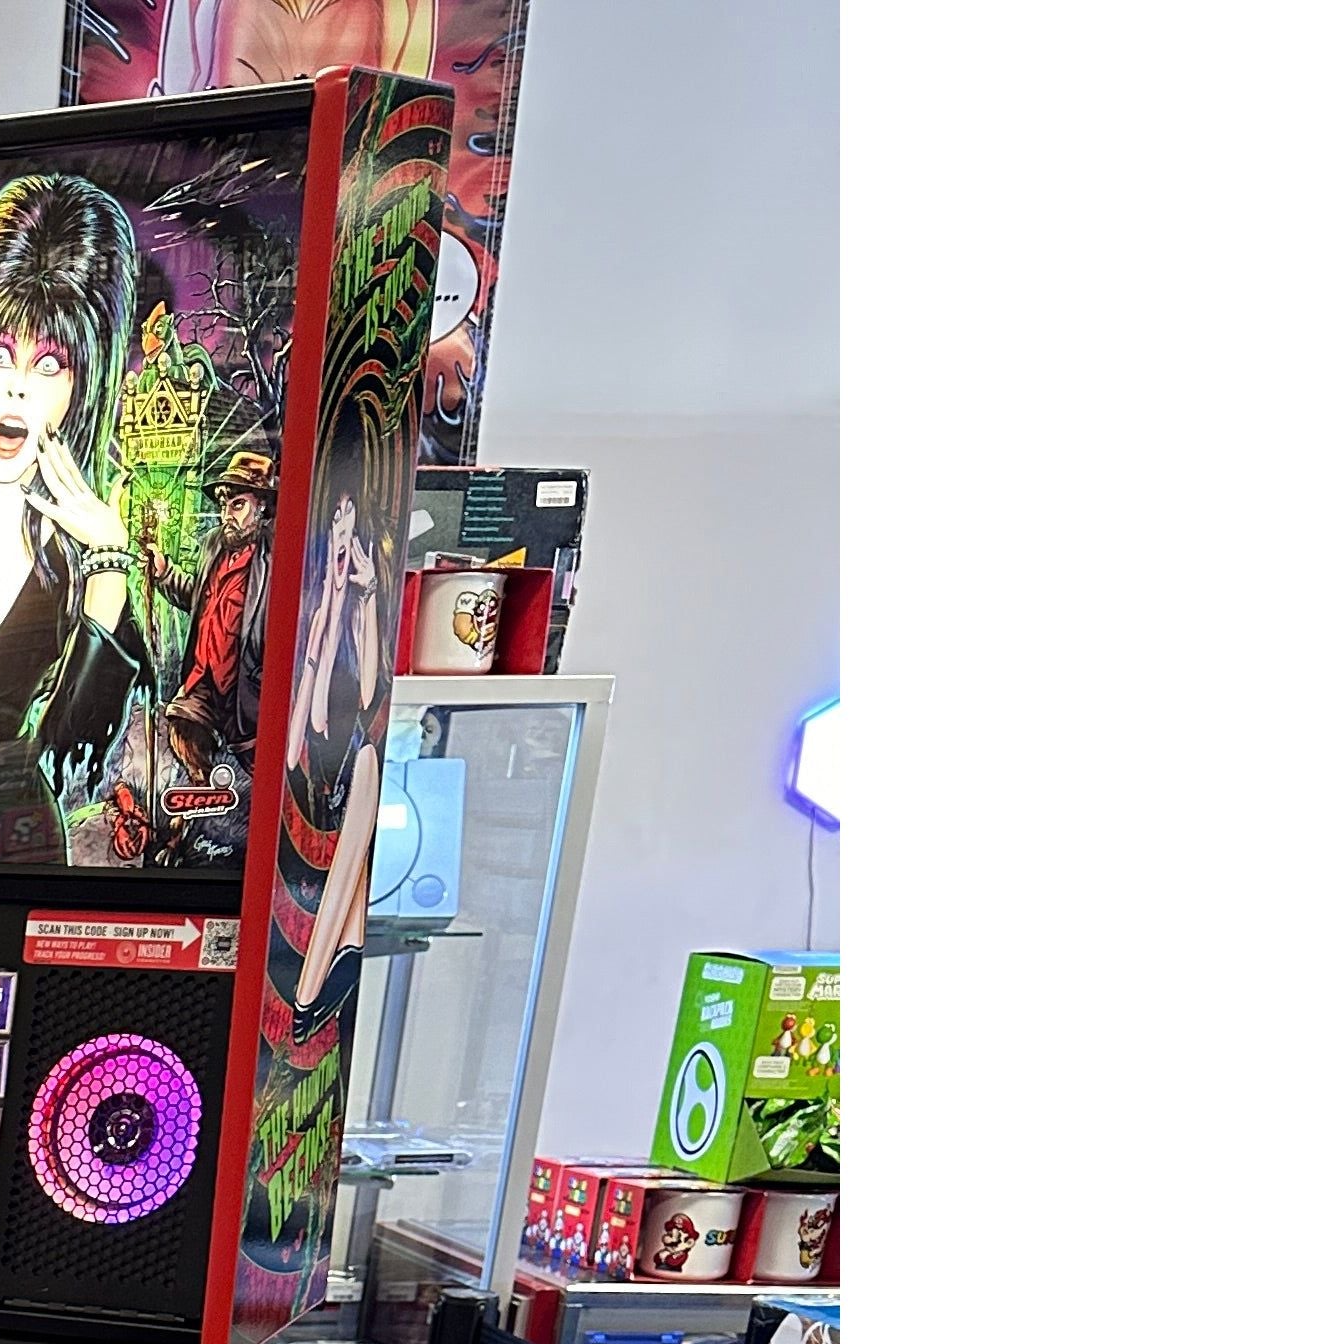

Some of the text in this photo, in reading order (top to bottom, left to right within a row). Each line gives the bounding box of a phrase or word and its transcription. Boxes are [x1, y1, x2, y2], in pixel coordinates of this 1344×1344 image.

[170, 793, 230, 809] Stern
[37, 923, 175, 939] SCAN THIS CODE SIGN UP NOW!
[137, 943, 172, 958] INSIDER
[260, 1100, 289, 1172] THE
